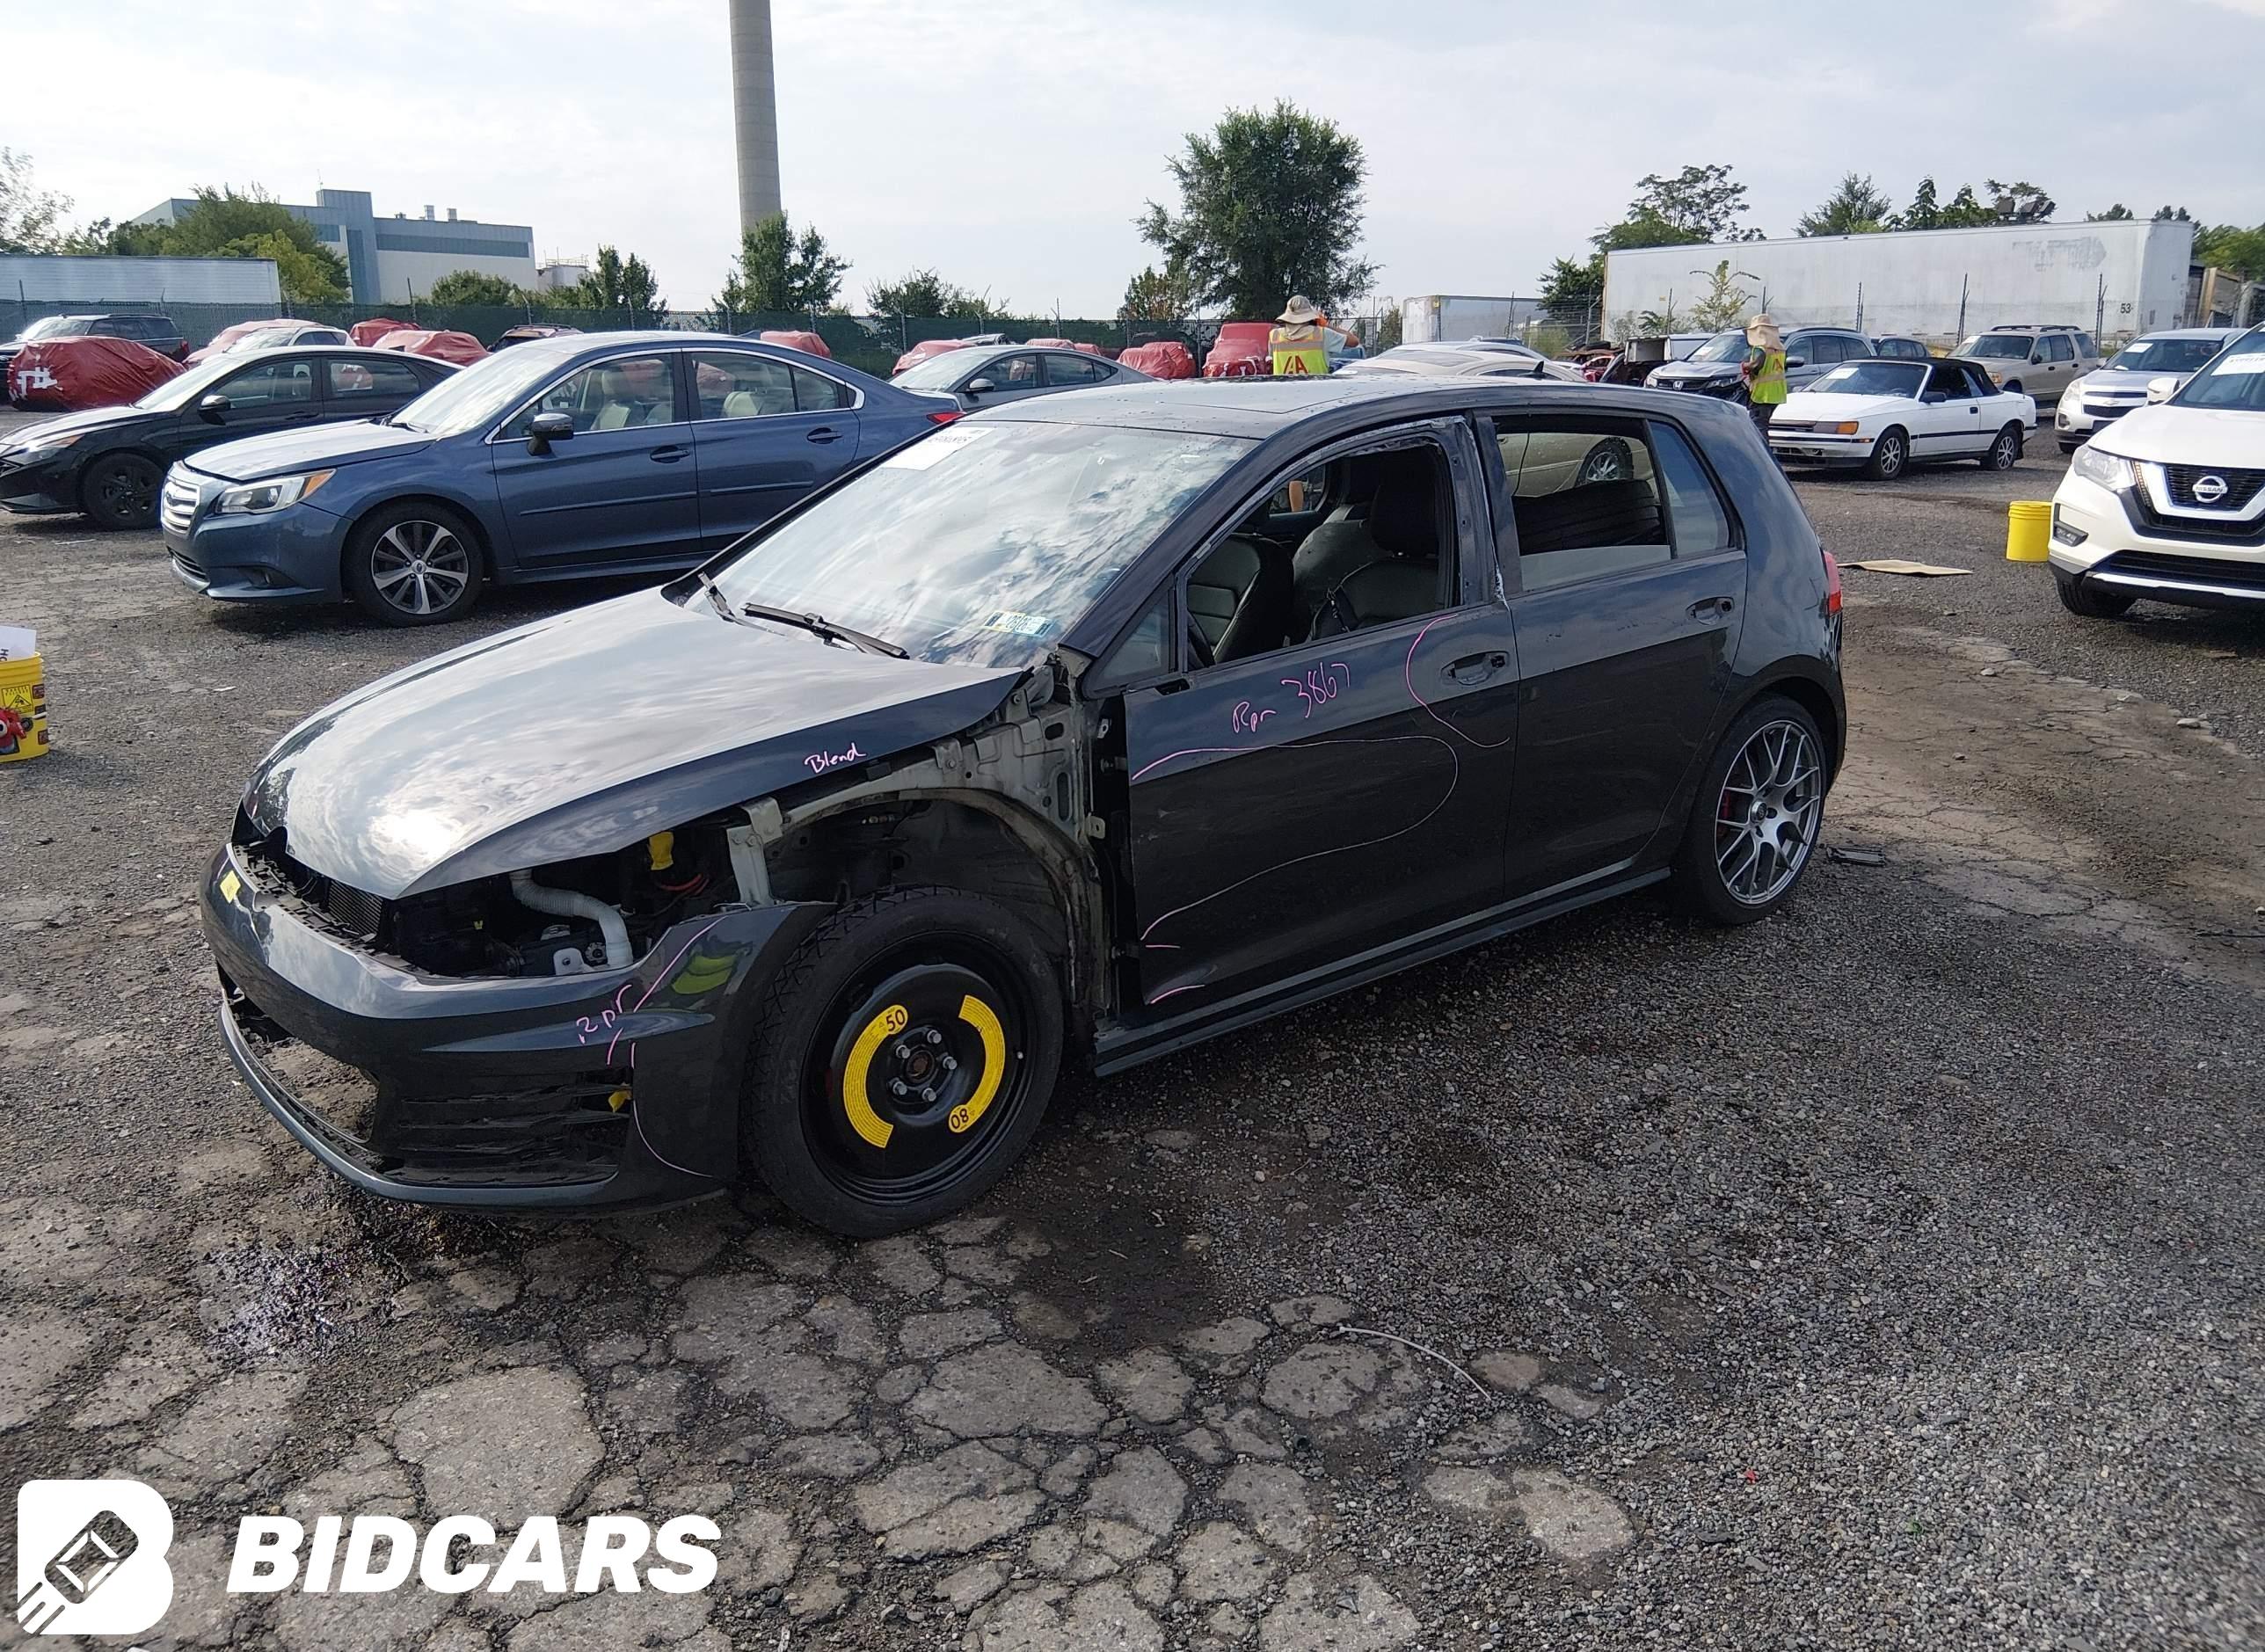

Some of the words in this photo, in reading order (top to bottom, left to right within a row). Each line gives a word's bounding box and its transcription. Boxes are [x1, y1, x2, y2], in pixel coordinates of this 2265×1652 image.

[2120, 302, 2131, 314] 53
[804, 742, 867, 774] Blend
[885, 1009, 906, 1032] 50
